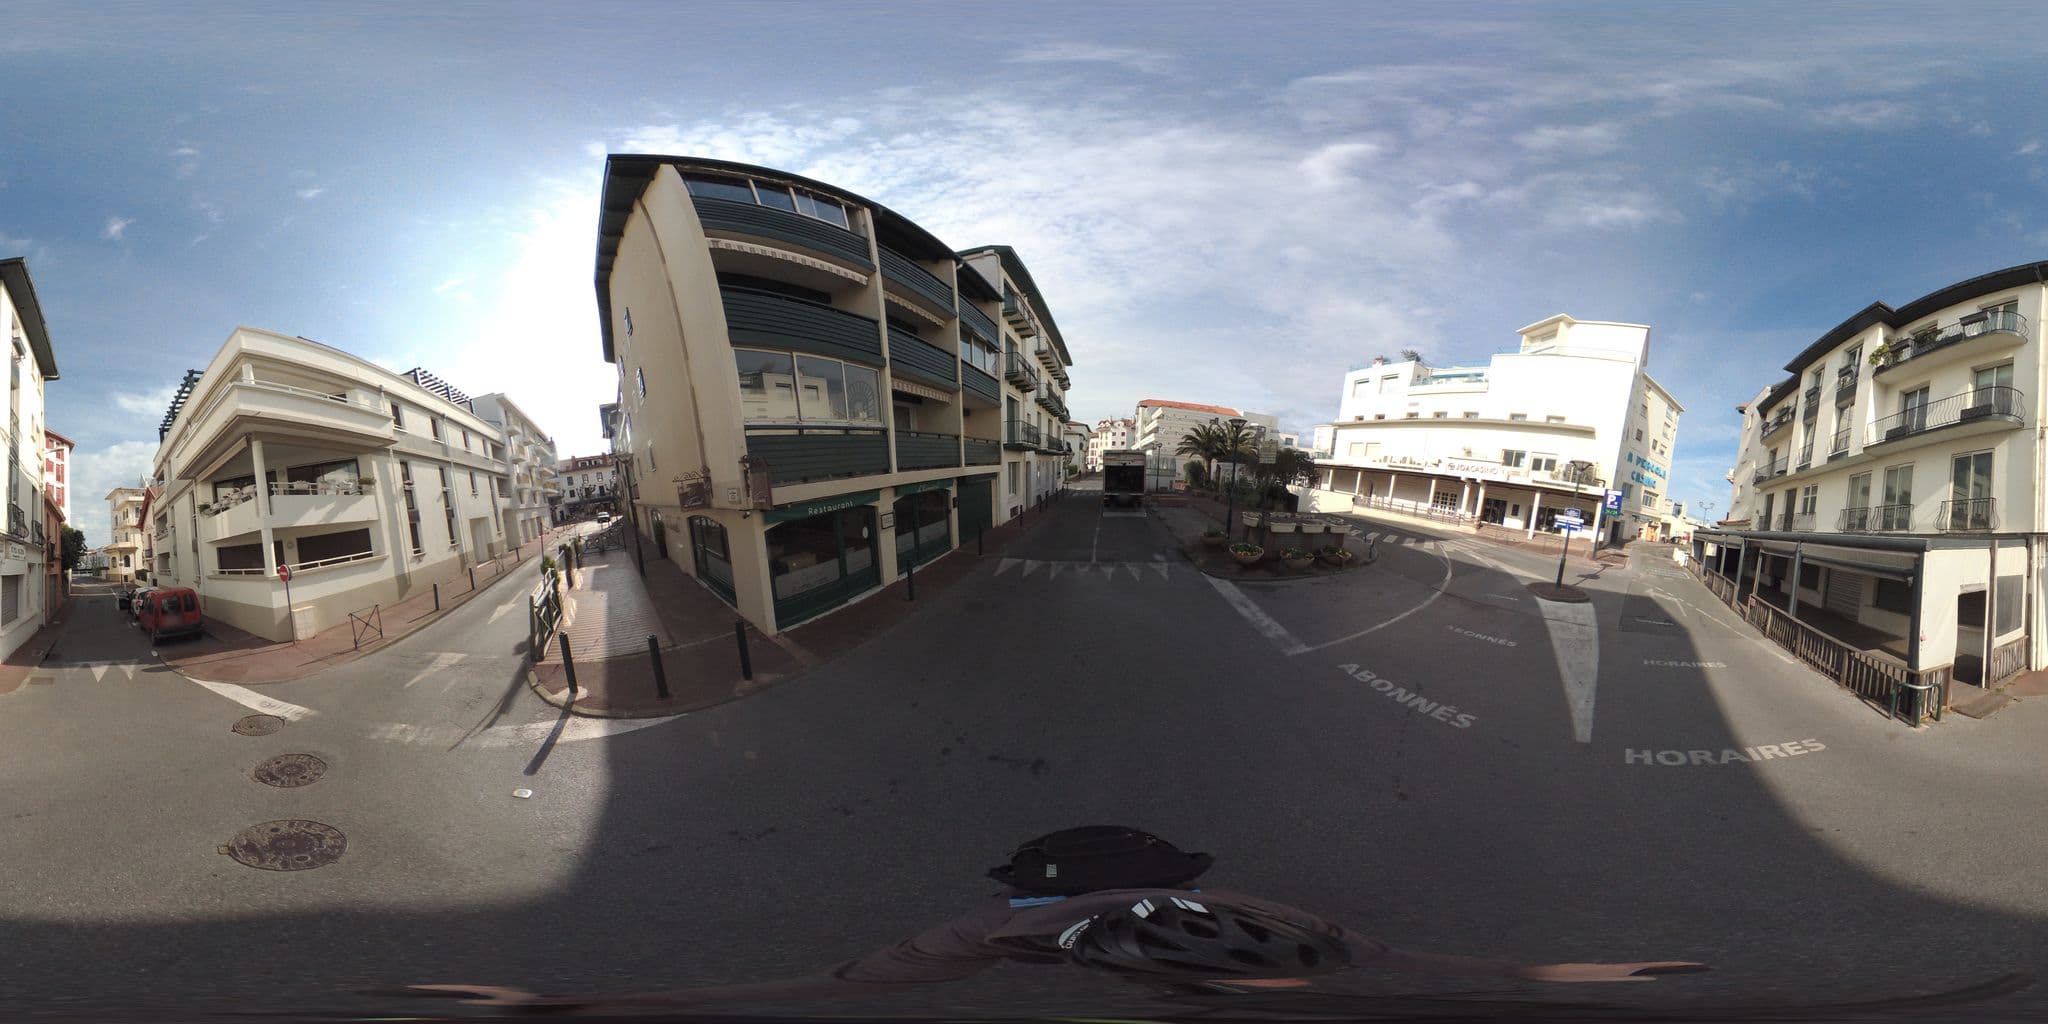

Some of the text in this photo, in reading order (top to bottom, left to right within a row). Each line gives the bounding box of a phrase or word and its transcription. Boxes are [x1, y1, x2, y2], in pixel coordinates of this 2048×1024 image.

[808, 501, 853, 515] Restaurant
[1643, 659, 1727, 668] HORAIRES
[1336, 662, 1478, 729] ABONNÉS
[1624, 738, 1826, 766] HORAIRES
